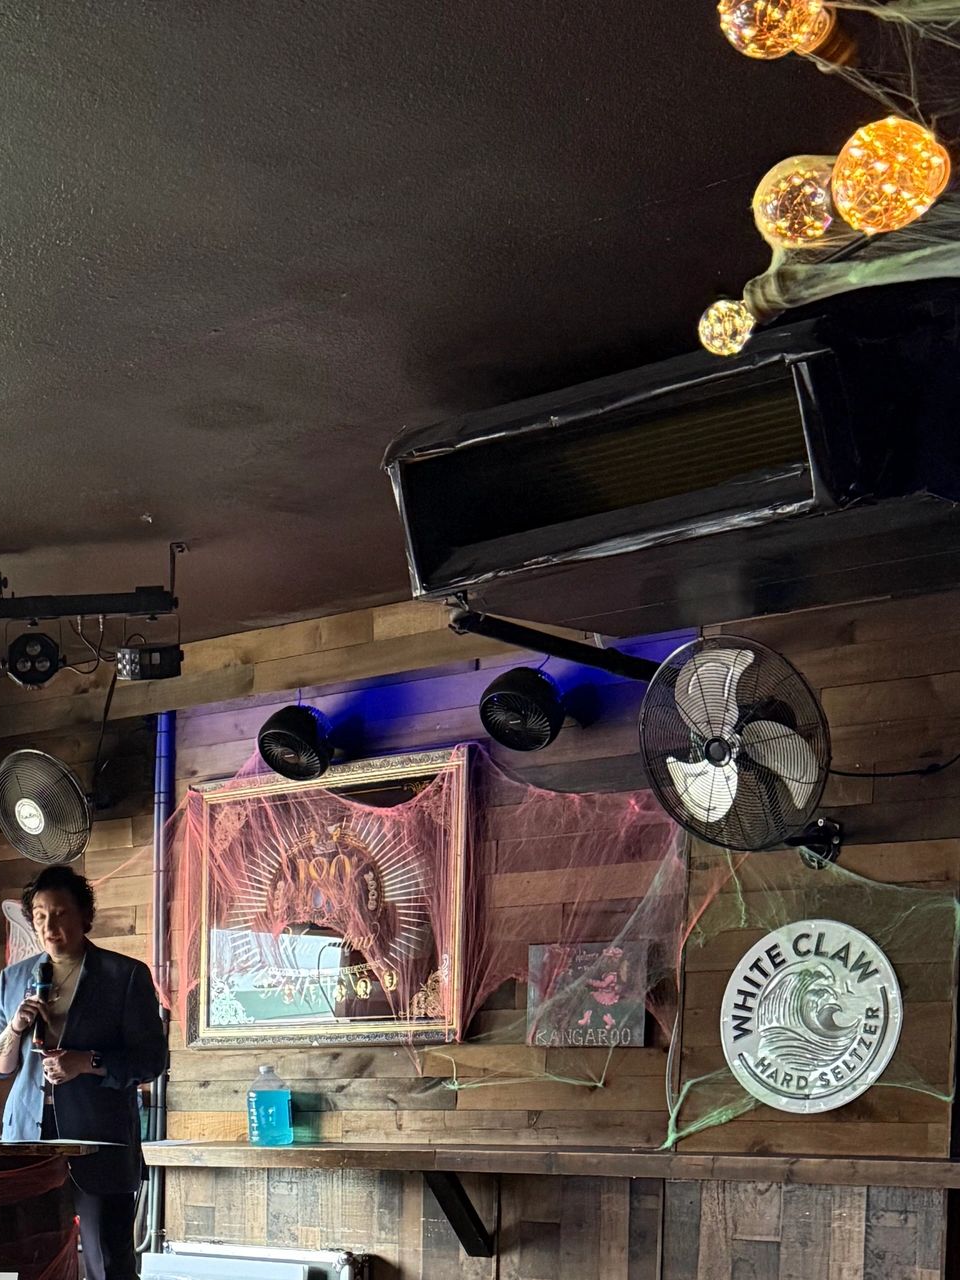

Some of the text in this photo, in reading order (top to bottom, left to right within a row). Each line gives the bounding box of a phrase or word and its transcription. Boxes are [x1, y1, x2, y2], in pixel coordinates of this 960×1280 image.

[732, 931, 880, 1044] WHITE CLAW
[535, 1028, 631, 1047] KANGAROO
[754, 1005, 880, 1091] HARD SELTZER
